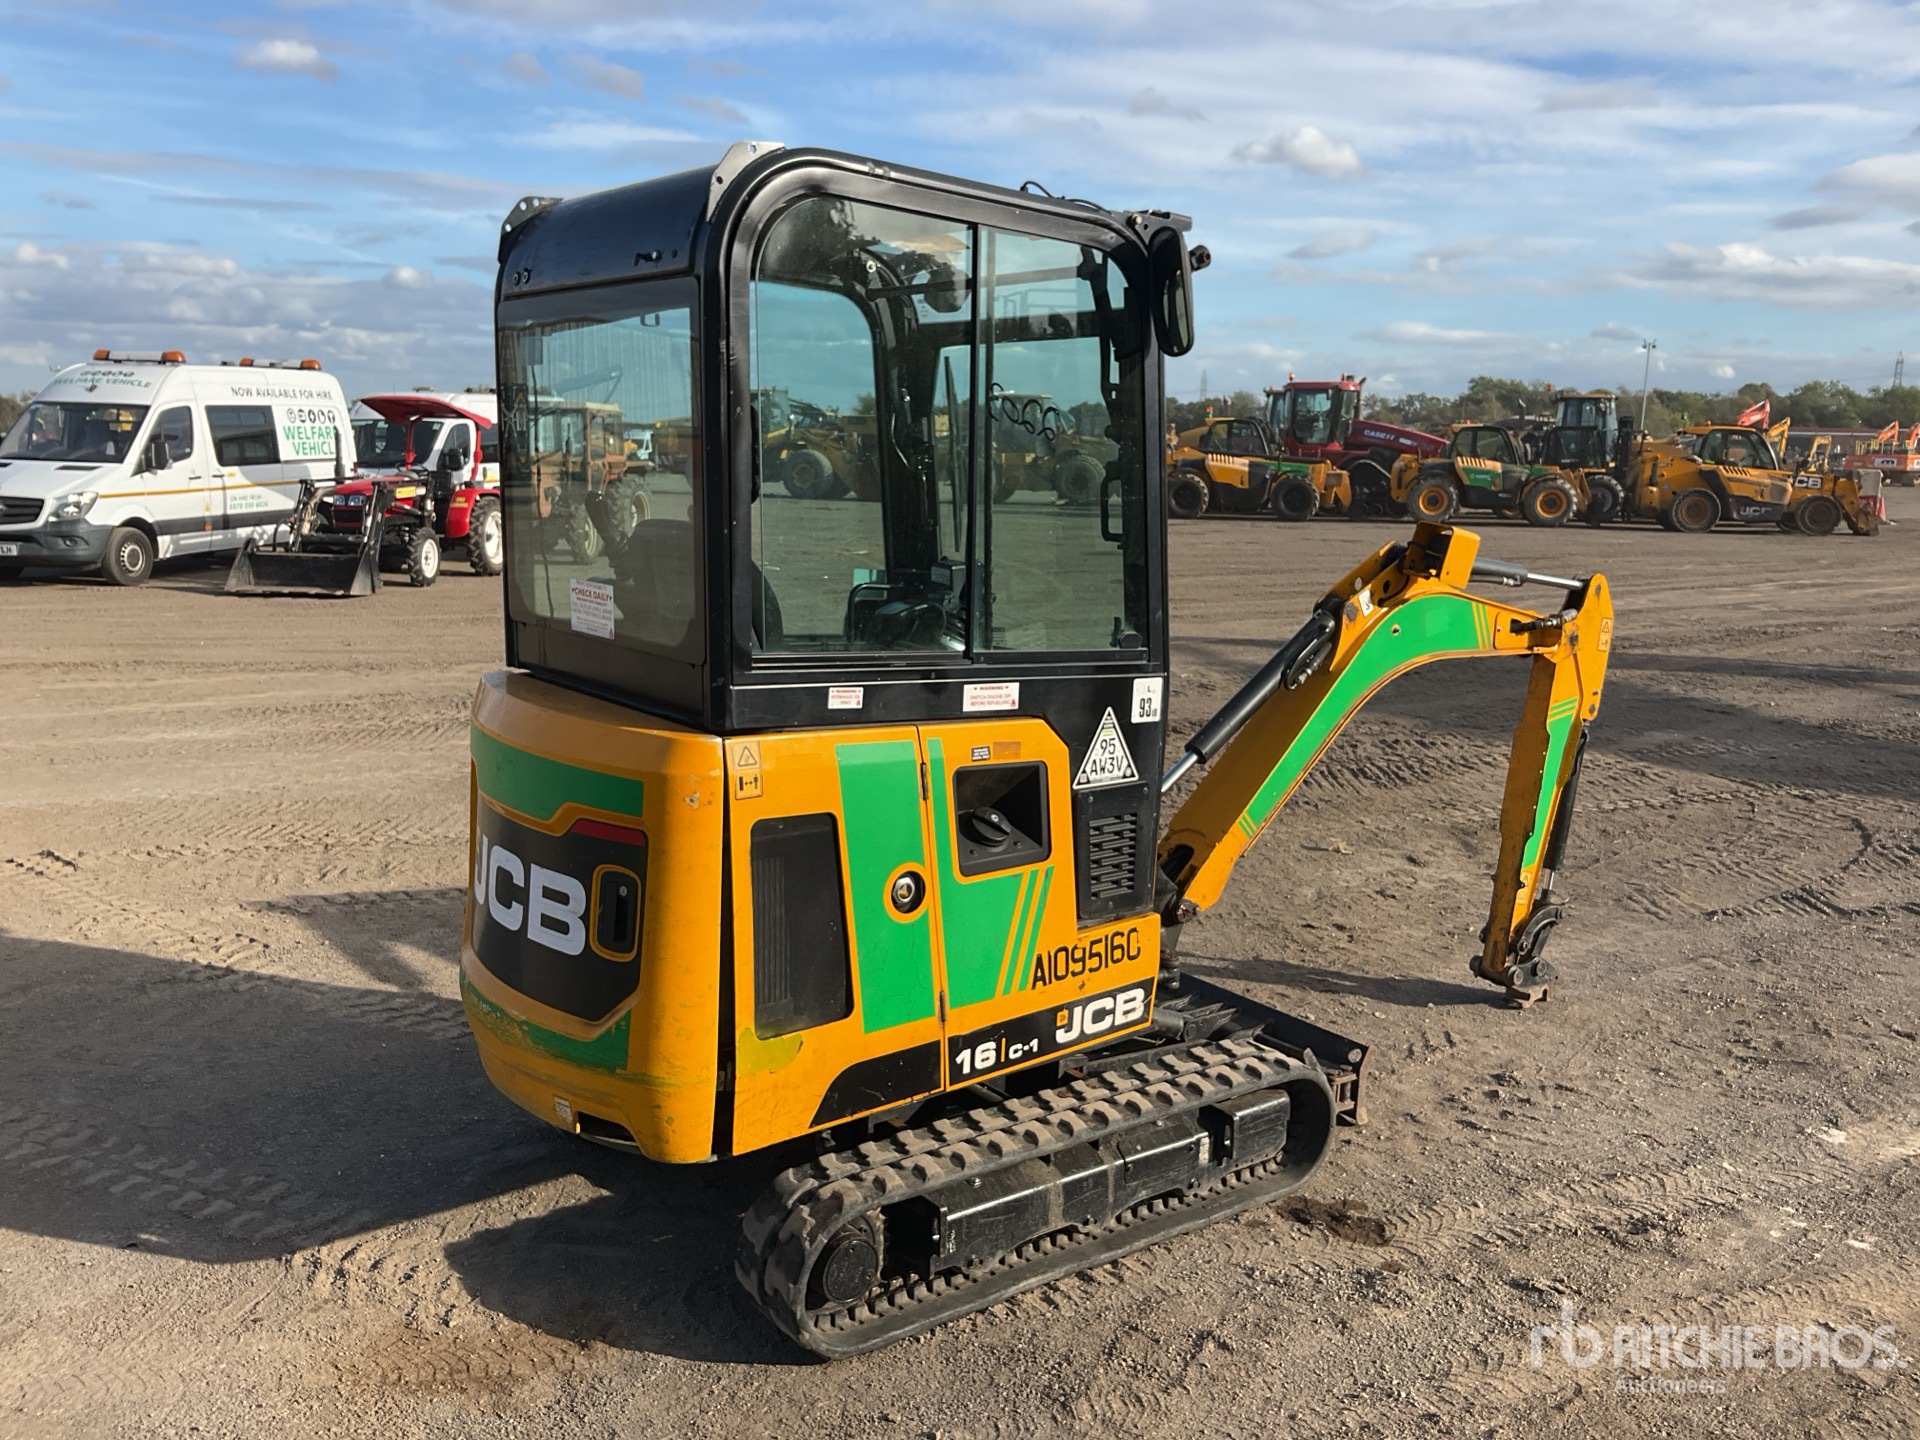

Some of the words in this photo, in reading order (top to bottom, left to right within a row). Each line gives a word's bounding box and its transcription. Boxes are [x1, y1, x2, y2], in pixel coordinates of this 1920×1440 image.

[105, 378, 152, 389] VEHICLE
[231, 386, 253, 397] NOW
[256, 387, 298, 399] AVAILABLE
[299, 389, 313, 399] FOR
[316, 390, 333, 400] HIRE
[283, 425, 334, 440] WELFAR
[292, 441, 335, 456] VEHICL
[1795, 476, 1822, 489] CB
[574, 587, 593, 599] CHECK
[593, 590, 610, 602] DAILY
[1100, 737, 1116, 756] 95
[1090, 755, 1124, 776] AW3V
[474, 833, 587, 956] JCB
[1055, 988, 1145, 1044] JCB
[955, 1041, 997, 1075] 16
